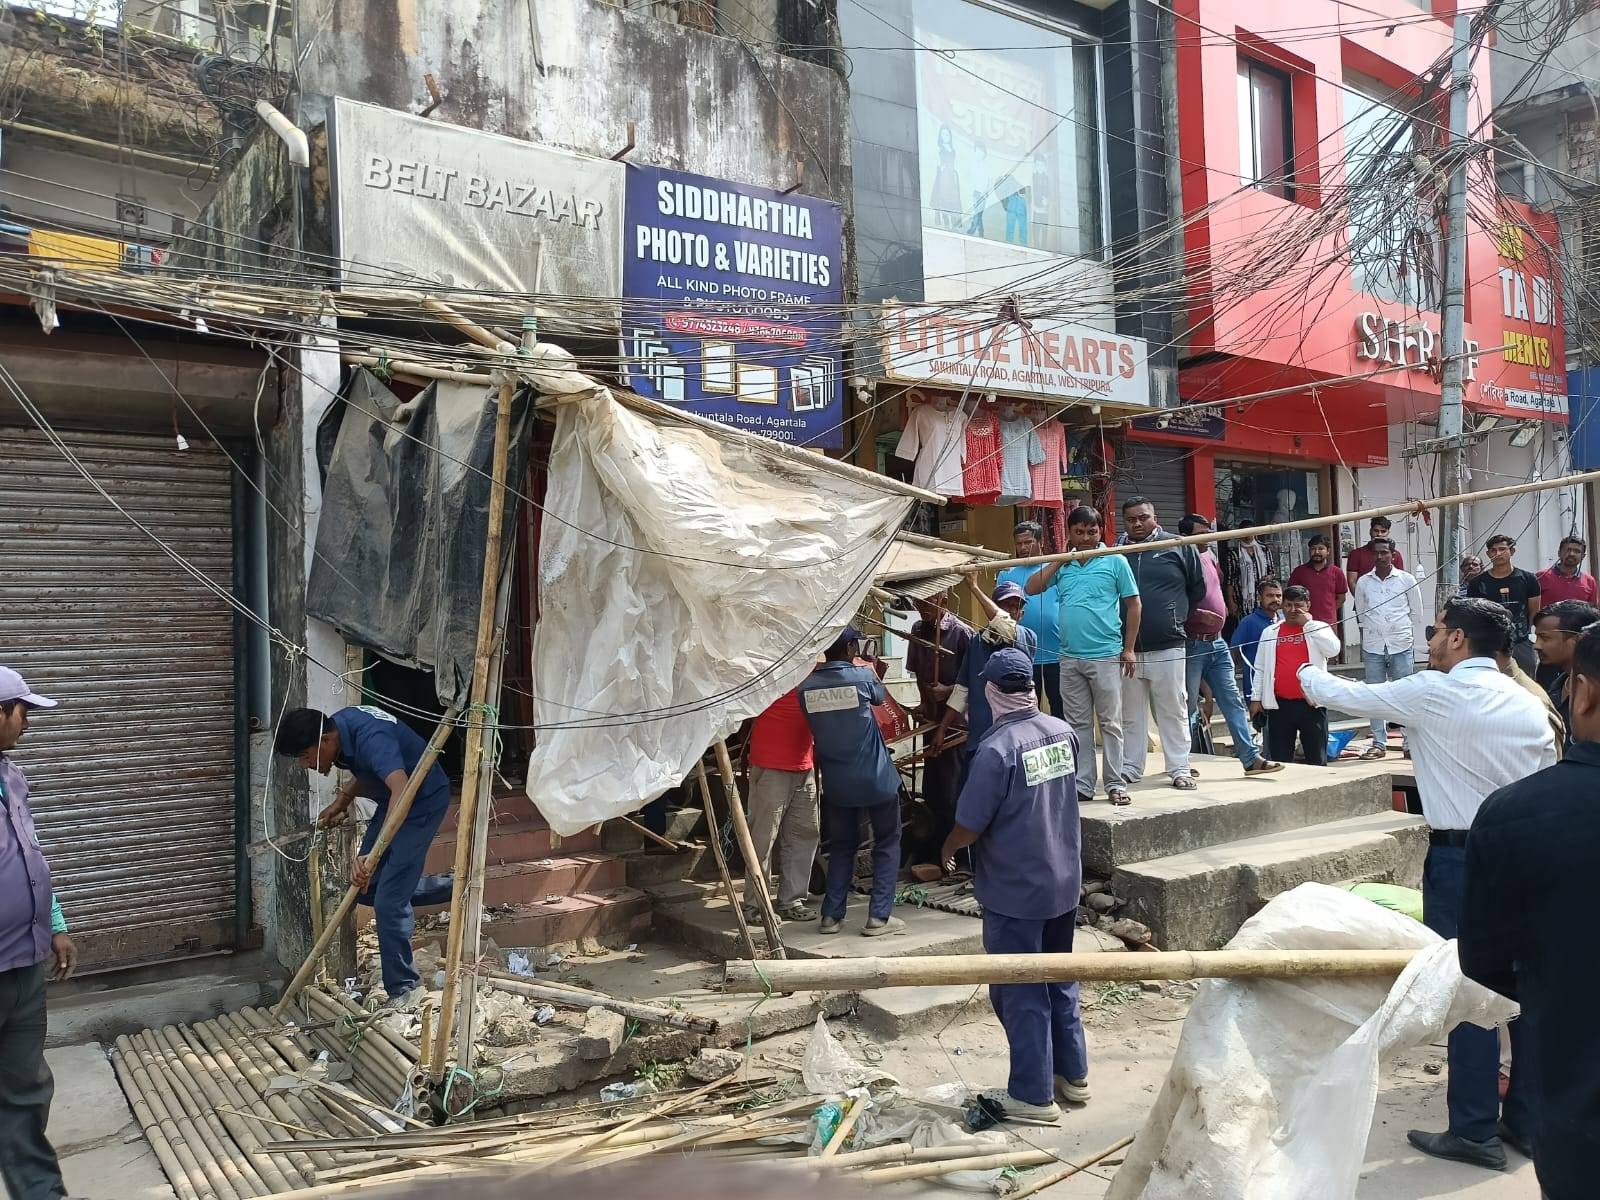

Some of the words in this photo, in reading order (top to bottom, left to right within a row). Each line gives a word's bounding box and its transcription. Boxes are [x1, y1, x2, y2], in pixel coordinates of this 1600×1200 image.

[364, 153, 458, 201] BELT
[463, 175, 603, 230] BAZAAR
[657, 180, 813, 240] SIDDHARTHA
[636, 225, 709, 268] PHOTO
[714, 242, 730, 271] &
[734, 240, 831, 287] VARIETIES
[657, 275, 683, 290] ALL
[686, 279, 719, 294] KIND
[723, 284, 767, 301] PHOTO
[771, 291, 811, 305] FRAME
[898, 306, 1010, 363] LITTLE
[1021, 328, 1135, 379] HEARTS
[929, 359, 978, 377] SAKUNTALA
[737, 413, 764, 426] Road,
[766, 416, 807, 428] Agartala
